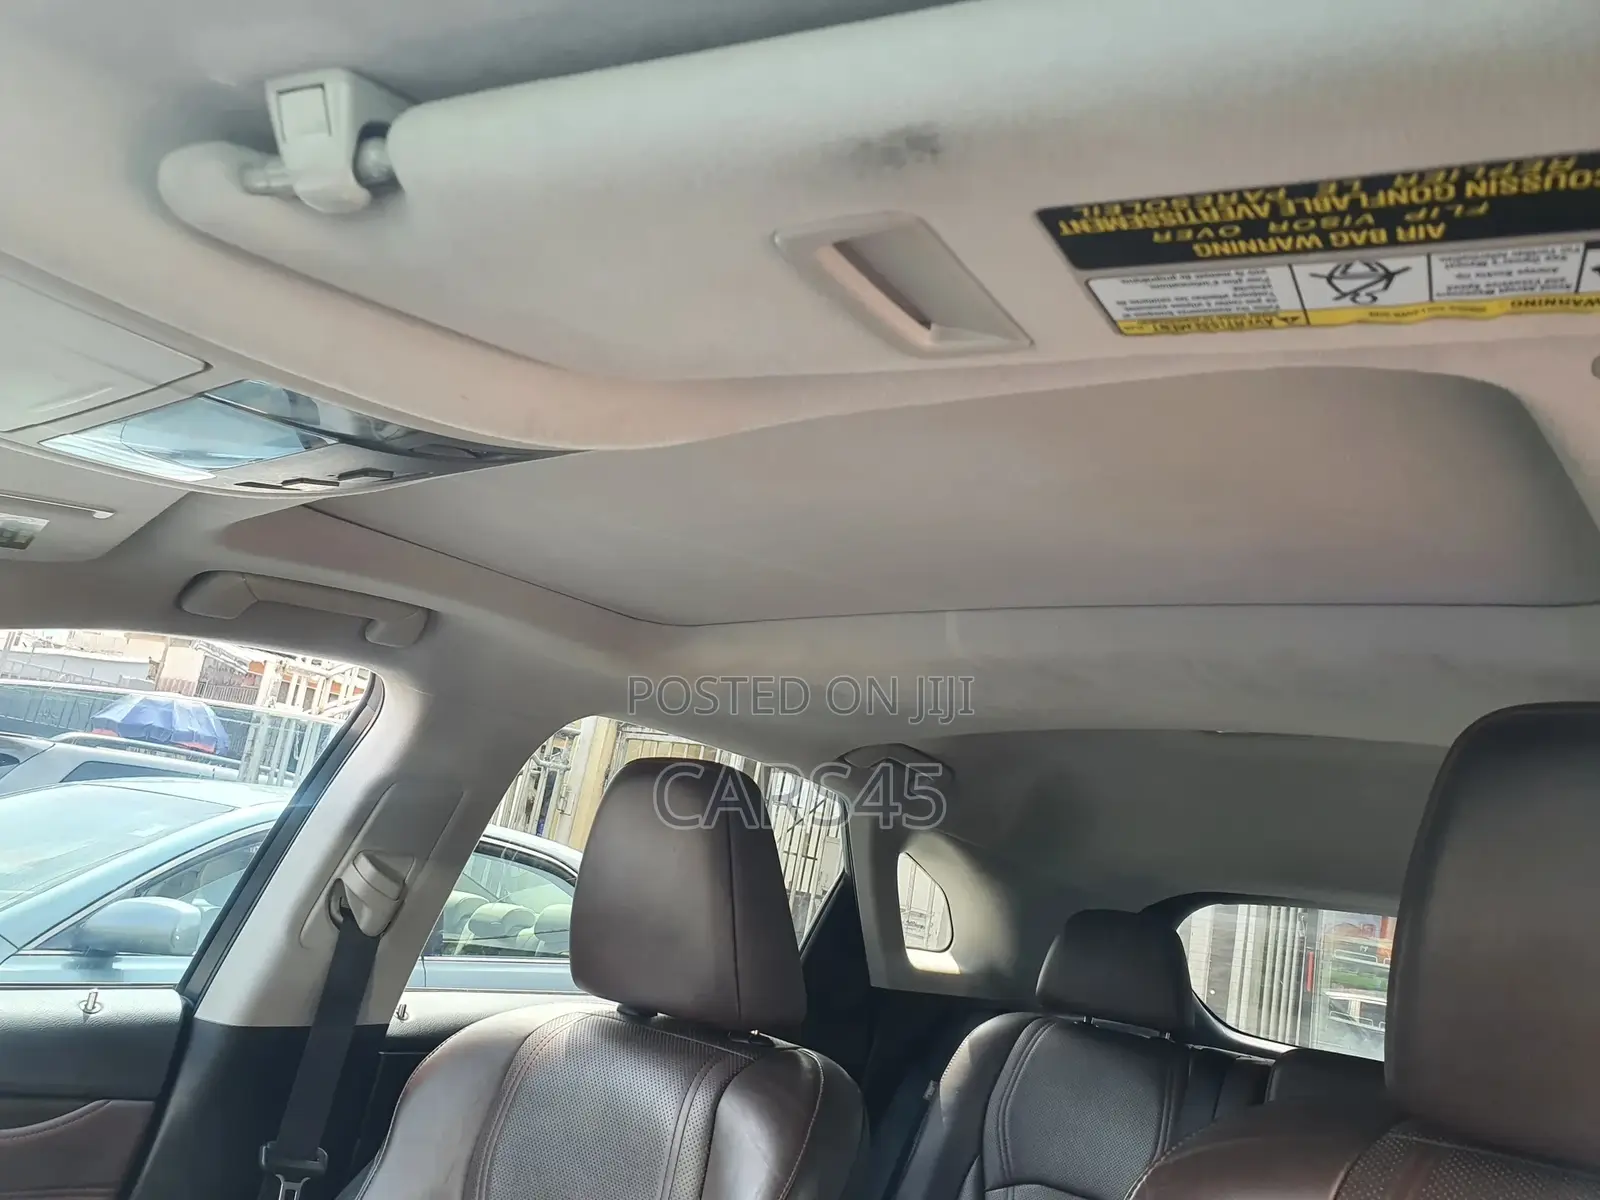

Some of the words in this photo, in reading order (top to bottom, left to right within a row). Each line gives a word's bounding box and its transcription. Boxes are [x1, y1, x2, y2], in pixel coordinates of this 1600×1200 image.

[1280, 183, 1456, 217] GONFLABLE
[1058, 202, 1270, 236] AVERTISSEMENT
[1404, 201, 1489, 221] FLIP
[1268, 213, 1375, 234] VISOR
[1396, 222, 1446, 242] AIR
[1153, 225, 1240, 244] OVER
[1192, 233, 1324, 257] WARNING
[1329, 227, 1388, 248] BAG
